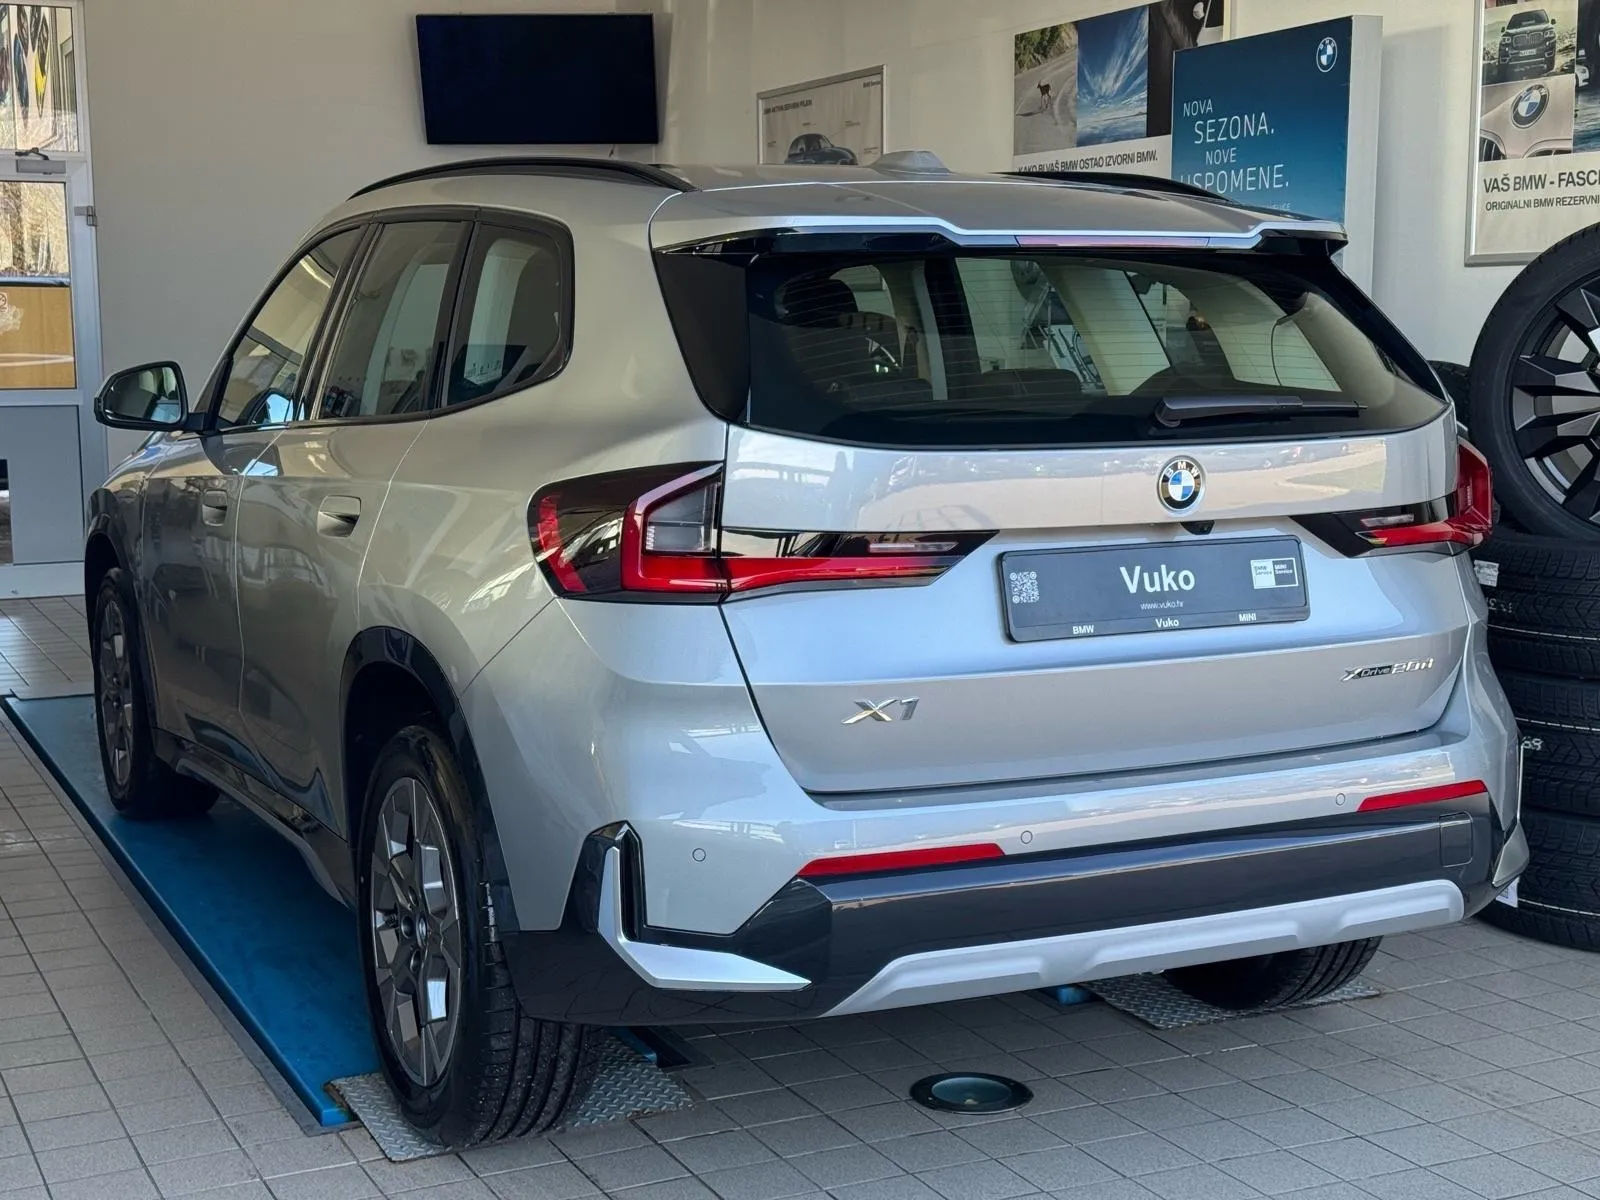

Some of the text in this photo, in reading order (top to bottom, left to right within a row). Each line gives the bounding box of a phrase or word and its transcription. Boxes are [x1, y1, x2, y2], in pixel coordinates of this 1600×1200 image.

[1183, 98, 1214, 117] NOVA
[1194, 111, 1275, 144] SEZONA.
[1060, 160, 1079, 172] BMW
[1079, 156, 1105, 170] OSTAO
[1105, 153, 1136, 167] IZVORNI
[1136, 149, 1158, 163] BMW.
[1205, 147, 1237, 165] NOVE
[1483, 173, 1511, 193] VAŠ
[1513, 174, 1547, 191] BMW
[1485, 195, 1600, 211] ORIGINALNI BMW REZERVNI
[1119, 564, 1195, 594] Vuko
[1140, 600, 1184, 610] www.vuko.hr
[1155, 617, 1180, 628] Vuko
[1238, 612, 1257, 622] MINI
[1072, 624, 1095, 635] BMW
[841, 697, 920, 724] X1
